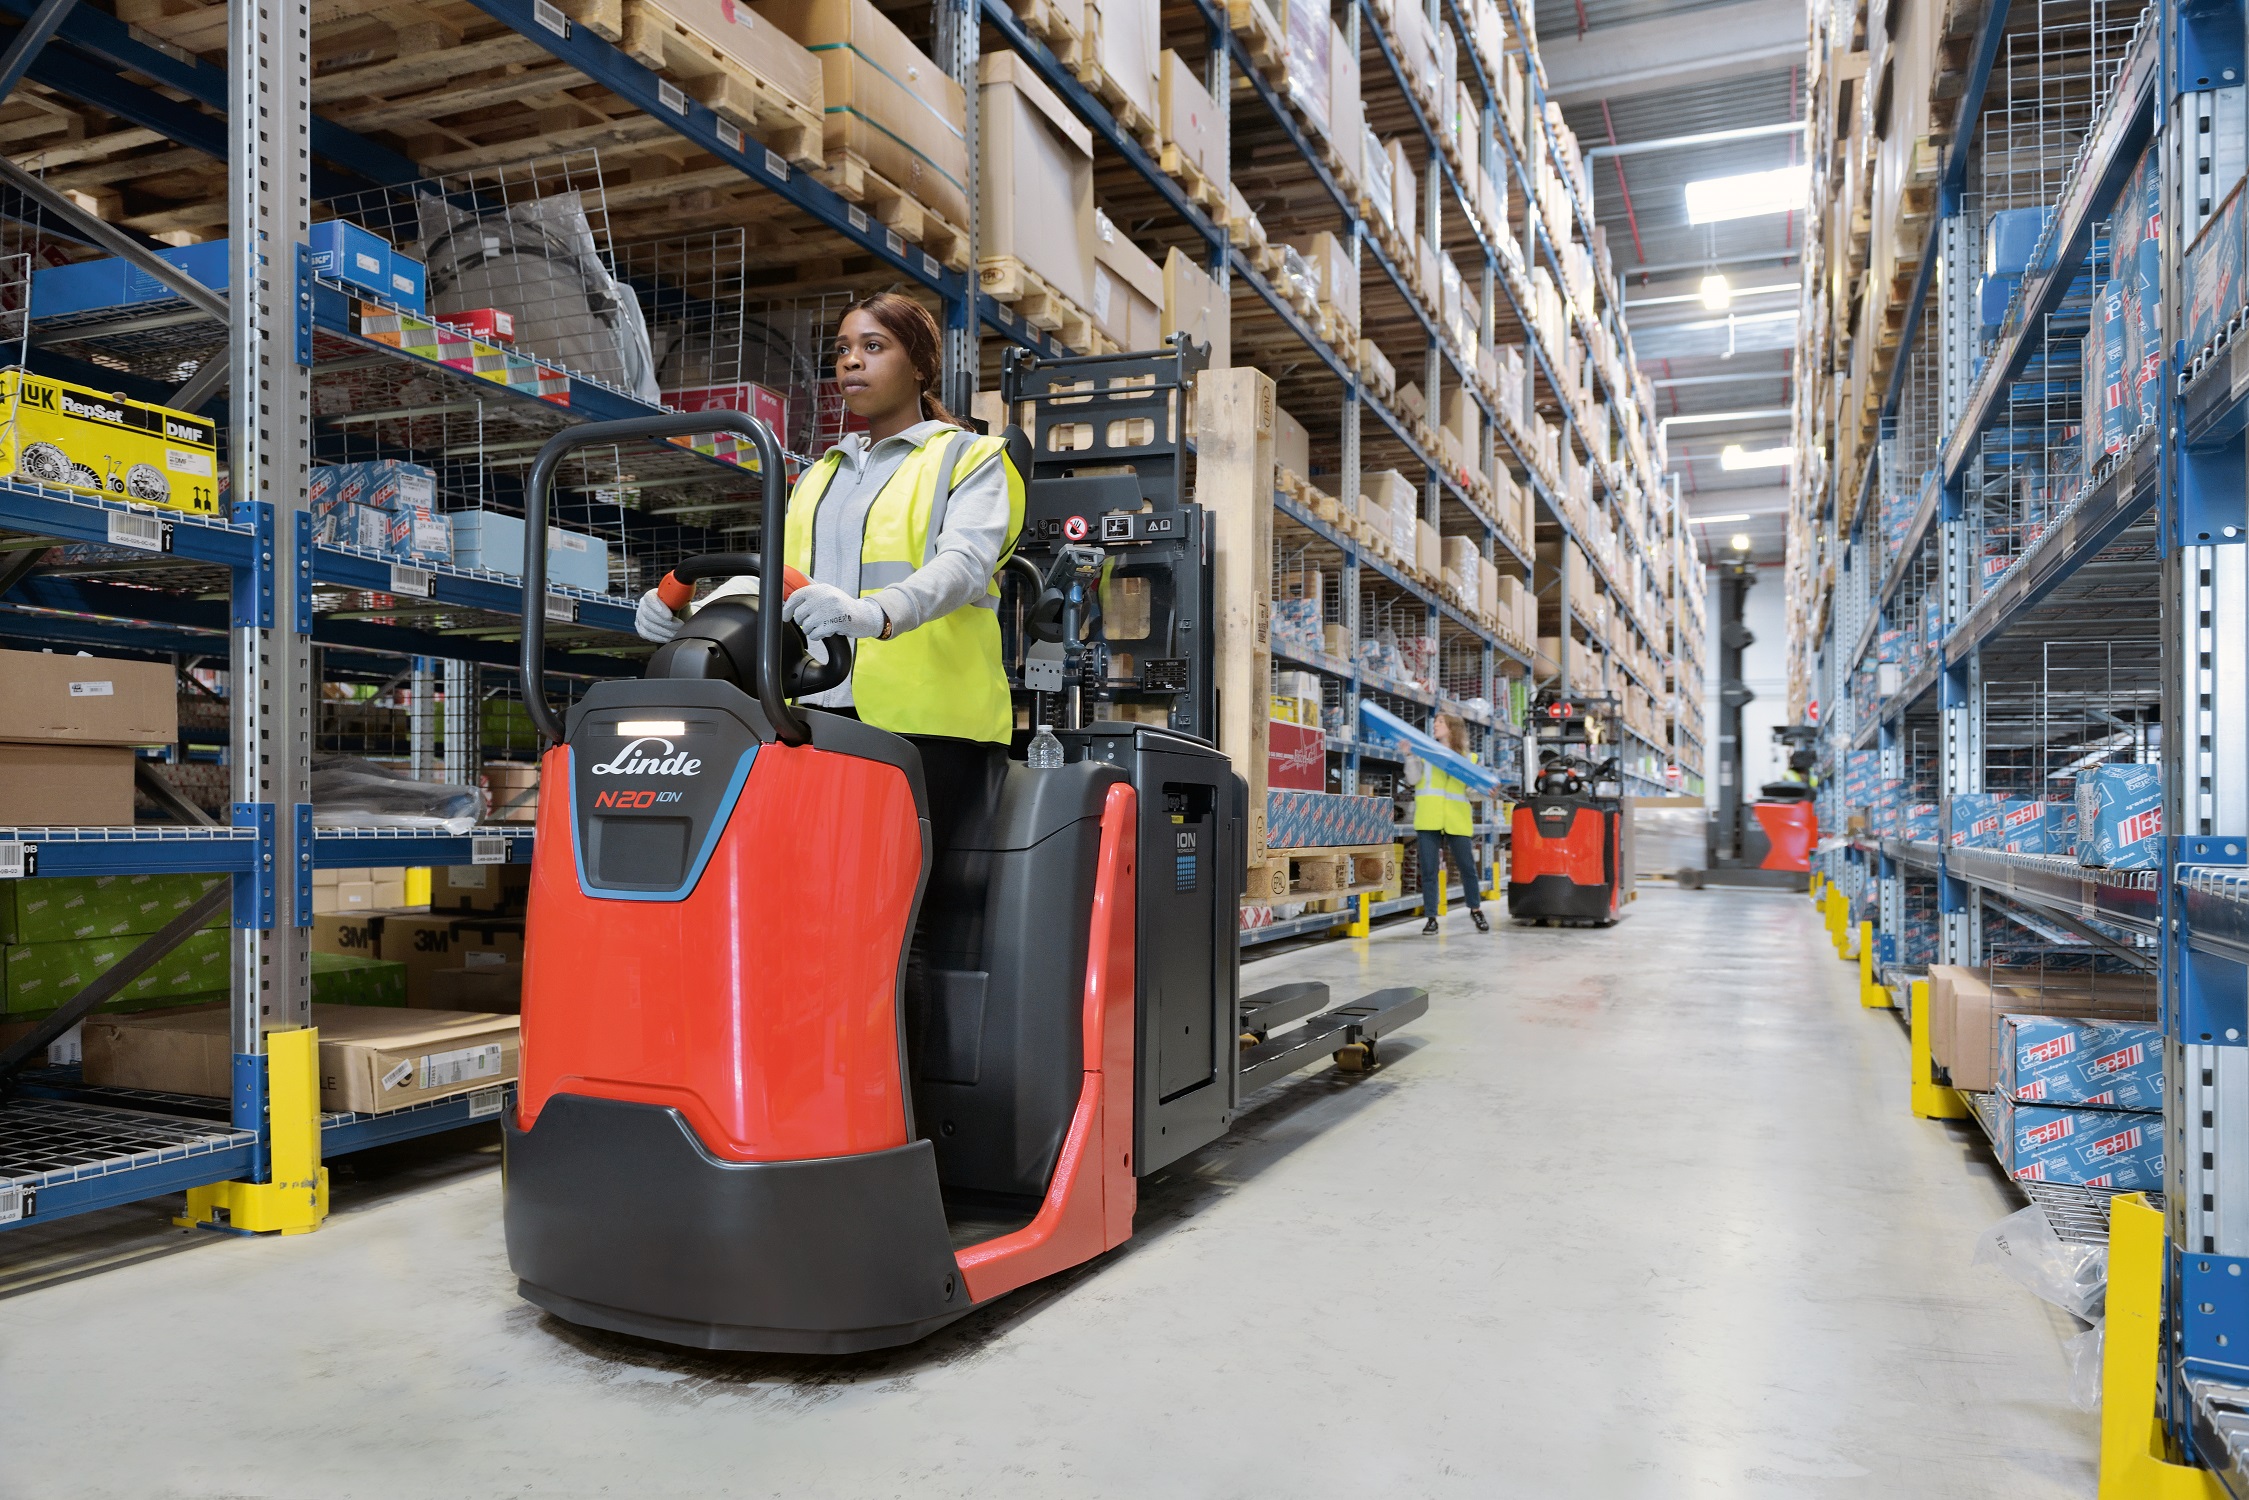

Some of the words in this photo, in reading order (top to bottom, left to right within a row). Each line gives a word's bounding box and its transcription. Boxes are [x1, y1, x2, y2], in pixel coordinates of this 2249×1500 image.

[61, 396, 124, 424] RepSet
[166, 421, 203, 442] DMF
[161, 523, 174, 533] 0C
[591, 737, 702, 776] Linde
[594, 790, 657, 809] N20
[656, 791, 683, 803] ION
[24, 844, 38, 854] 0B
[1176, 832, 1196, 848] ION
[1273, 875, 1284, 887] EPAL
[338, 925, 369, 948] 3M
[414, 929, 449, 953] 3M
[2021, 1042, 2060, 1066] depa
[2086, 1053, 2127, 1077] depa
[320, 1076, 337, 1091] LE
[2019, 1124, 2058, 1147] depa
[2085, 1135, 2124, 1159] depa
